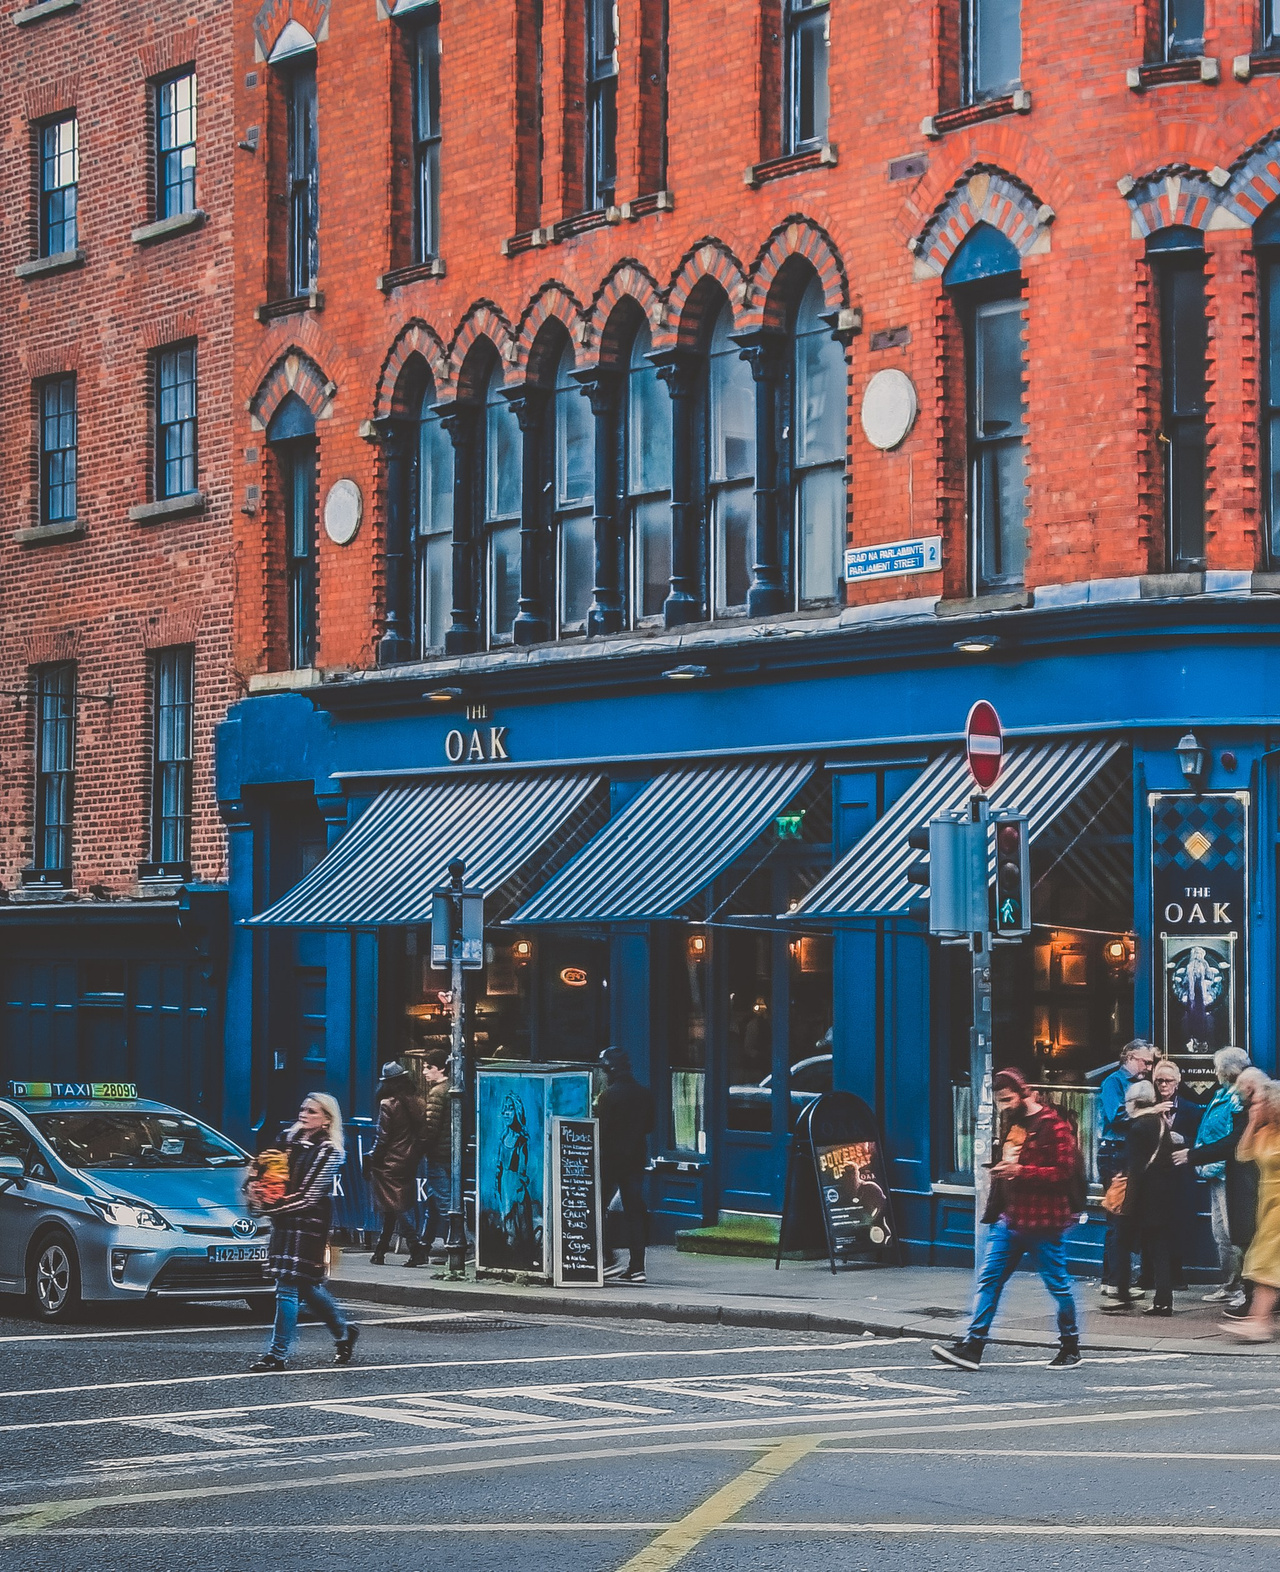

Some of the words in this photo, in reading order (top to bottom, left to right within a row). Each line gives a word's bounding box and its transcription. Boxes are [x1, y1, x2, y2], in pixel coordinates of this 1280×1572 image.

[868, 551, 878, 561] NA
[929, 546, 936, 560] 2
[849, 561, 890, 575] PARLIAMENT
[894, 557, 920, 569] STREET
[445, 727, 508, 762] OAK
[1184, 887, 1211, 898] THE
[1164, 902, 1233, 924] OAK
[53, 1083, 91, 1096] TAXI
[102, 1084, 137, 1098] 28090
[820, 1146, 864, 1172] POWERS
[122, 1372, 970, 1446] ENTRY
